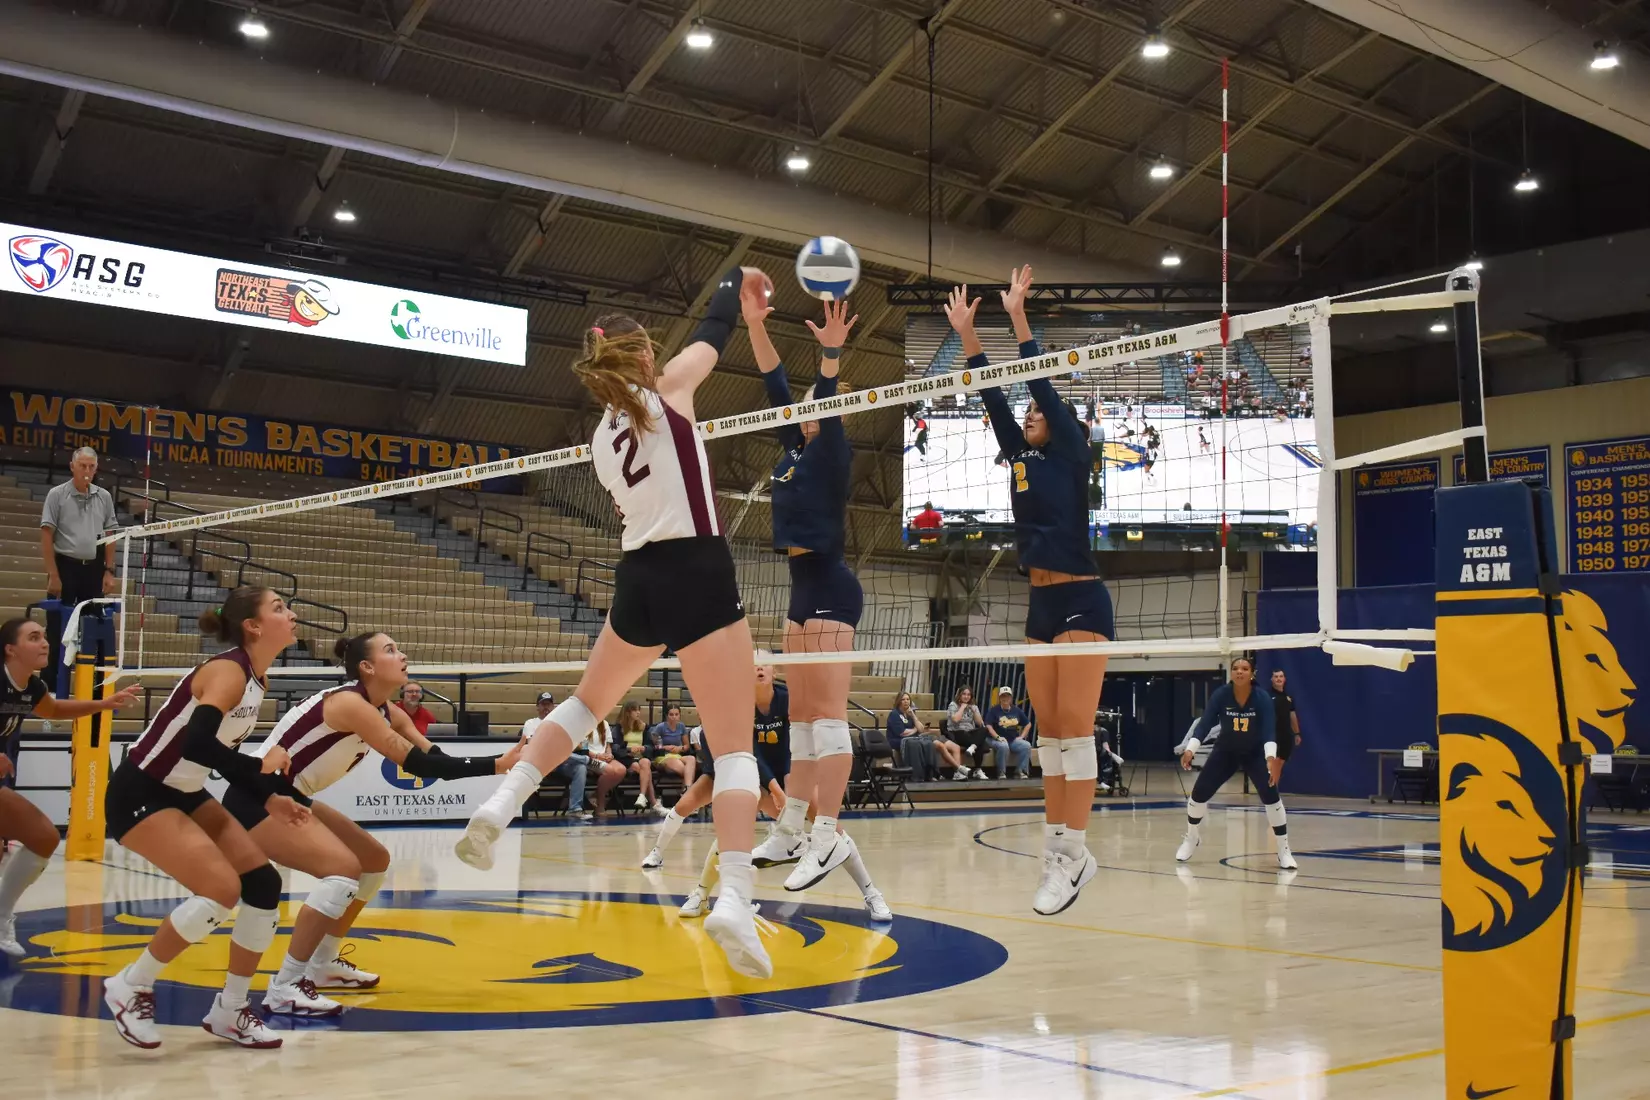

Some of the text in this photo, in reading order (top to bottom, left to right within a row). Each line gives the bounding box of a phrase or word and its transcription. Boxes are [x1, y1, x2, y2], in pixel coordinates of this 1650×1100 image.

[72, 254, 146, 288] ASG
[220, 272, 270, 287] NORTHEAST
[220, 282, 268, 303] TEXAS
[218, 300, 268, 315] GELLYBALL
[406, 316, 501, 350] Greenville
[1088, 333, 1177, 360] EAST TEXAS A&M
[980, 357, 1059, 380] EAST TEXAS A&M
[884, 377, 954, 399] EAST TEXAS A&M
[798, 395, 861, 415] EAST TEXAS A&M
[10, 391, 248, 446] WOMEN'S
[720, 412, 777, 429] EAST TEXAS A&M
[1019, 449, 1045, 460] EXAS
[1608, 444, 1646, 454] MEN'S
[153, 442, 324, 476] 4 NCAA TOURNAMENTS
[528, 457, 541, 465] EAST
[542, 453, 559, 462] TEXAS
[612, 428, 650, 488] 2
[1493, 456, 1528, 467] MEN'S
[361, 463, 369, 480] 9
[475, 467, 487, 475] EAST
[488, 464, 503, 472] TEXAS
[1380, 466, 1430, 478] WOMEN'S
[1507, 462, 1545, 474] COUNTRY
[426, 476, 437, 484] EAST
[1013, 462, 1028, 492] 2
[1401, 473, 1435, 484] COUNTRY
[1576, 473, 1650, 492] 1934 195
[1576, 490, 1650, 508] 1939 195
[1576, 509, 1614, 523] 1940
[1468, 527, 1503, 540] EAST
[1576, 525, 1614, 539] 1942
[1463, 545, 1507, 558] TEXAS
[1576, 538, 1650, 555] 1948 197
[1577, 557, 1615, 571] 1950
[1460, 562, 1511, 582] A&M
[1233, 718, 1249, 732] 17
[356, 794, 466, 807] EAST TEXAS A&M
[375, 807, 448, 816] UNIVERSITY
